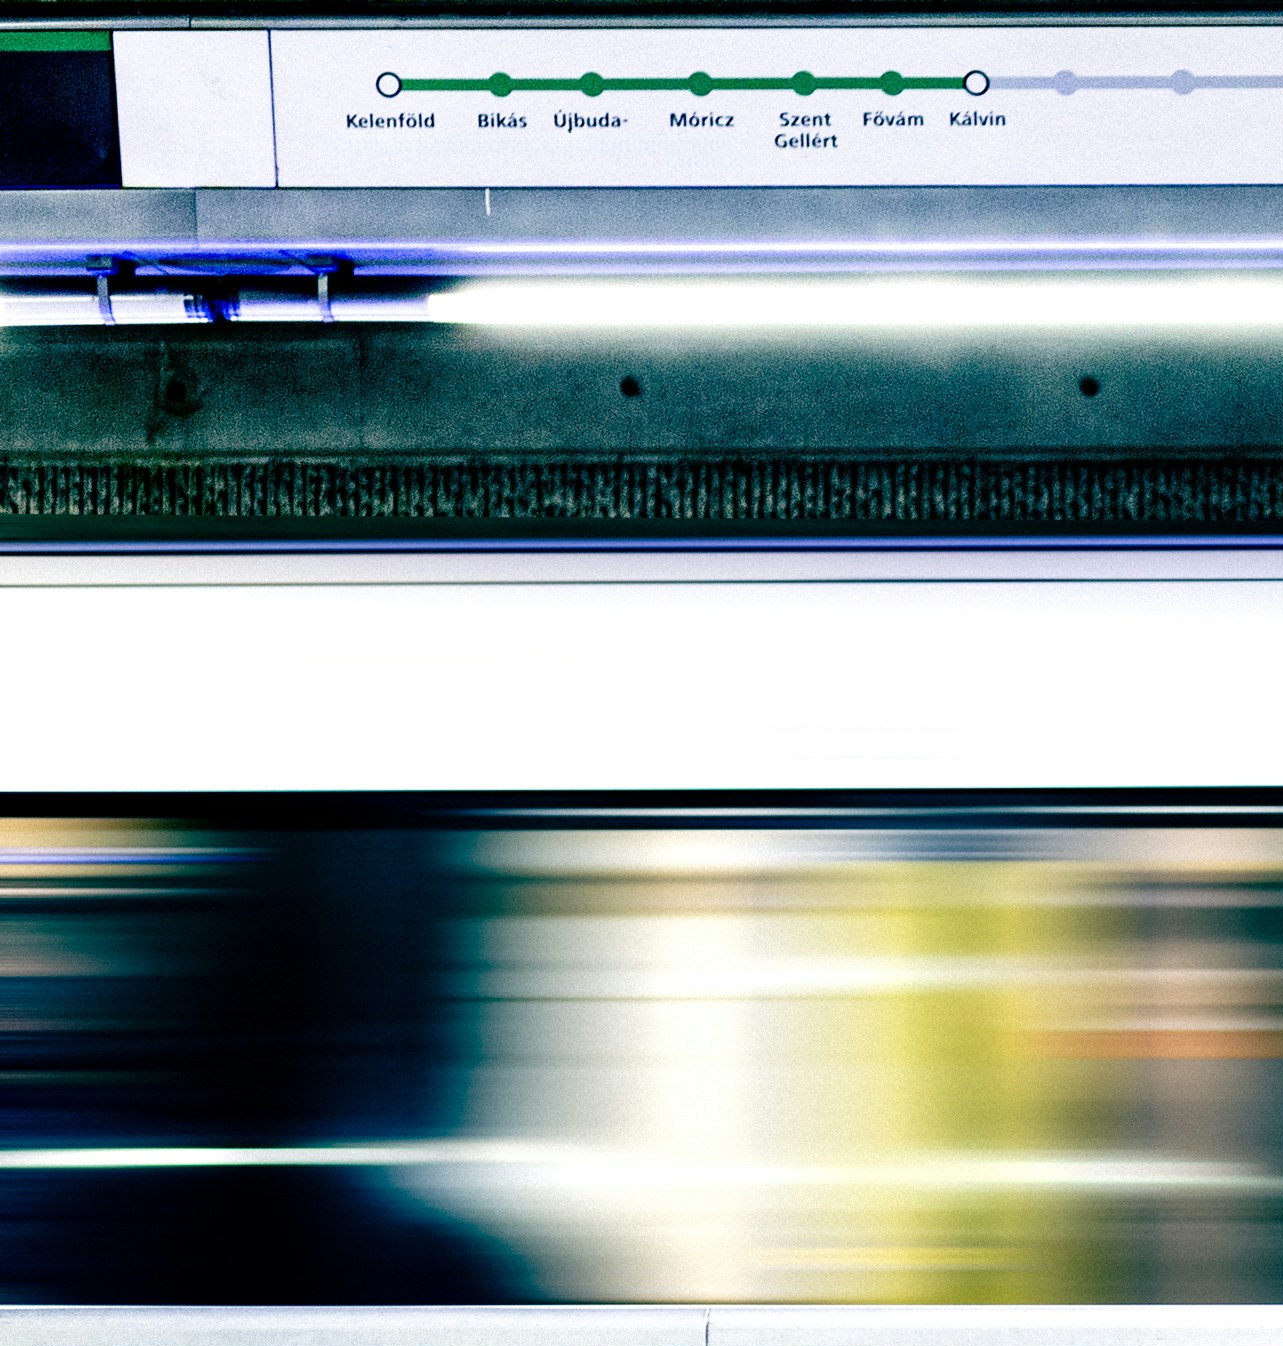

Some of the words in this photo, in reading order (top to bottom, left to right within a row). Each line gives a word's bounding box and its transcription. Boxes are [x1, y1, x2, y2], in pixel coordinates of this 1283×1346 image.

[346, 112, 436, 129] Kelenföld
[477, 112, 528, 129] Bikás
[553, 110, 628, 134] Újbuda-
[669, 112, 735, 128] Móricz
[779, 111, 831, 127] Szent
[862, 111, 925, 127] Fővám
[949, 110, 1006, 127] Kálvin
[774, 133, 838, 149] Gellért
